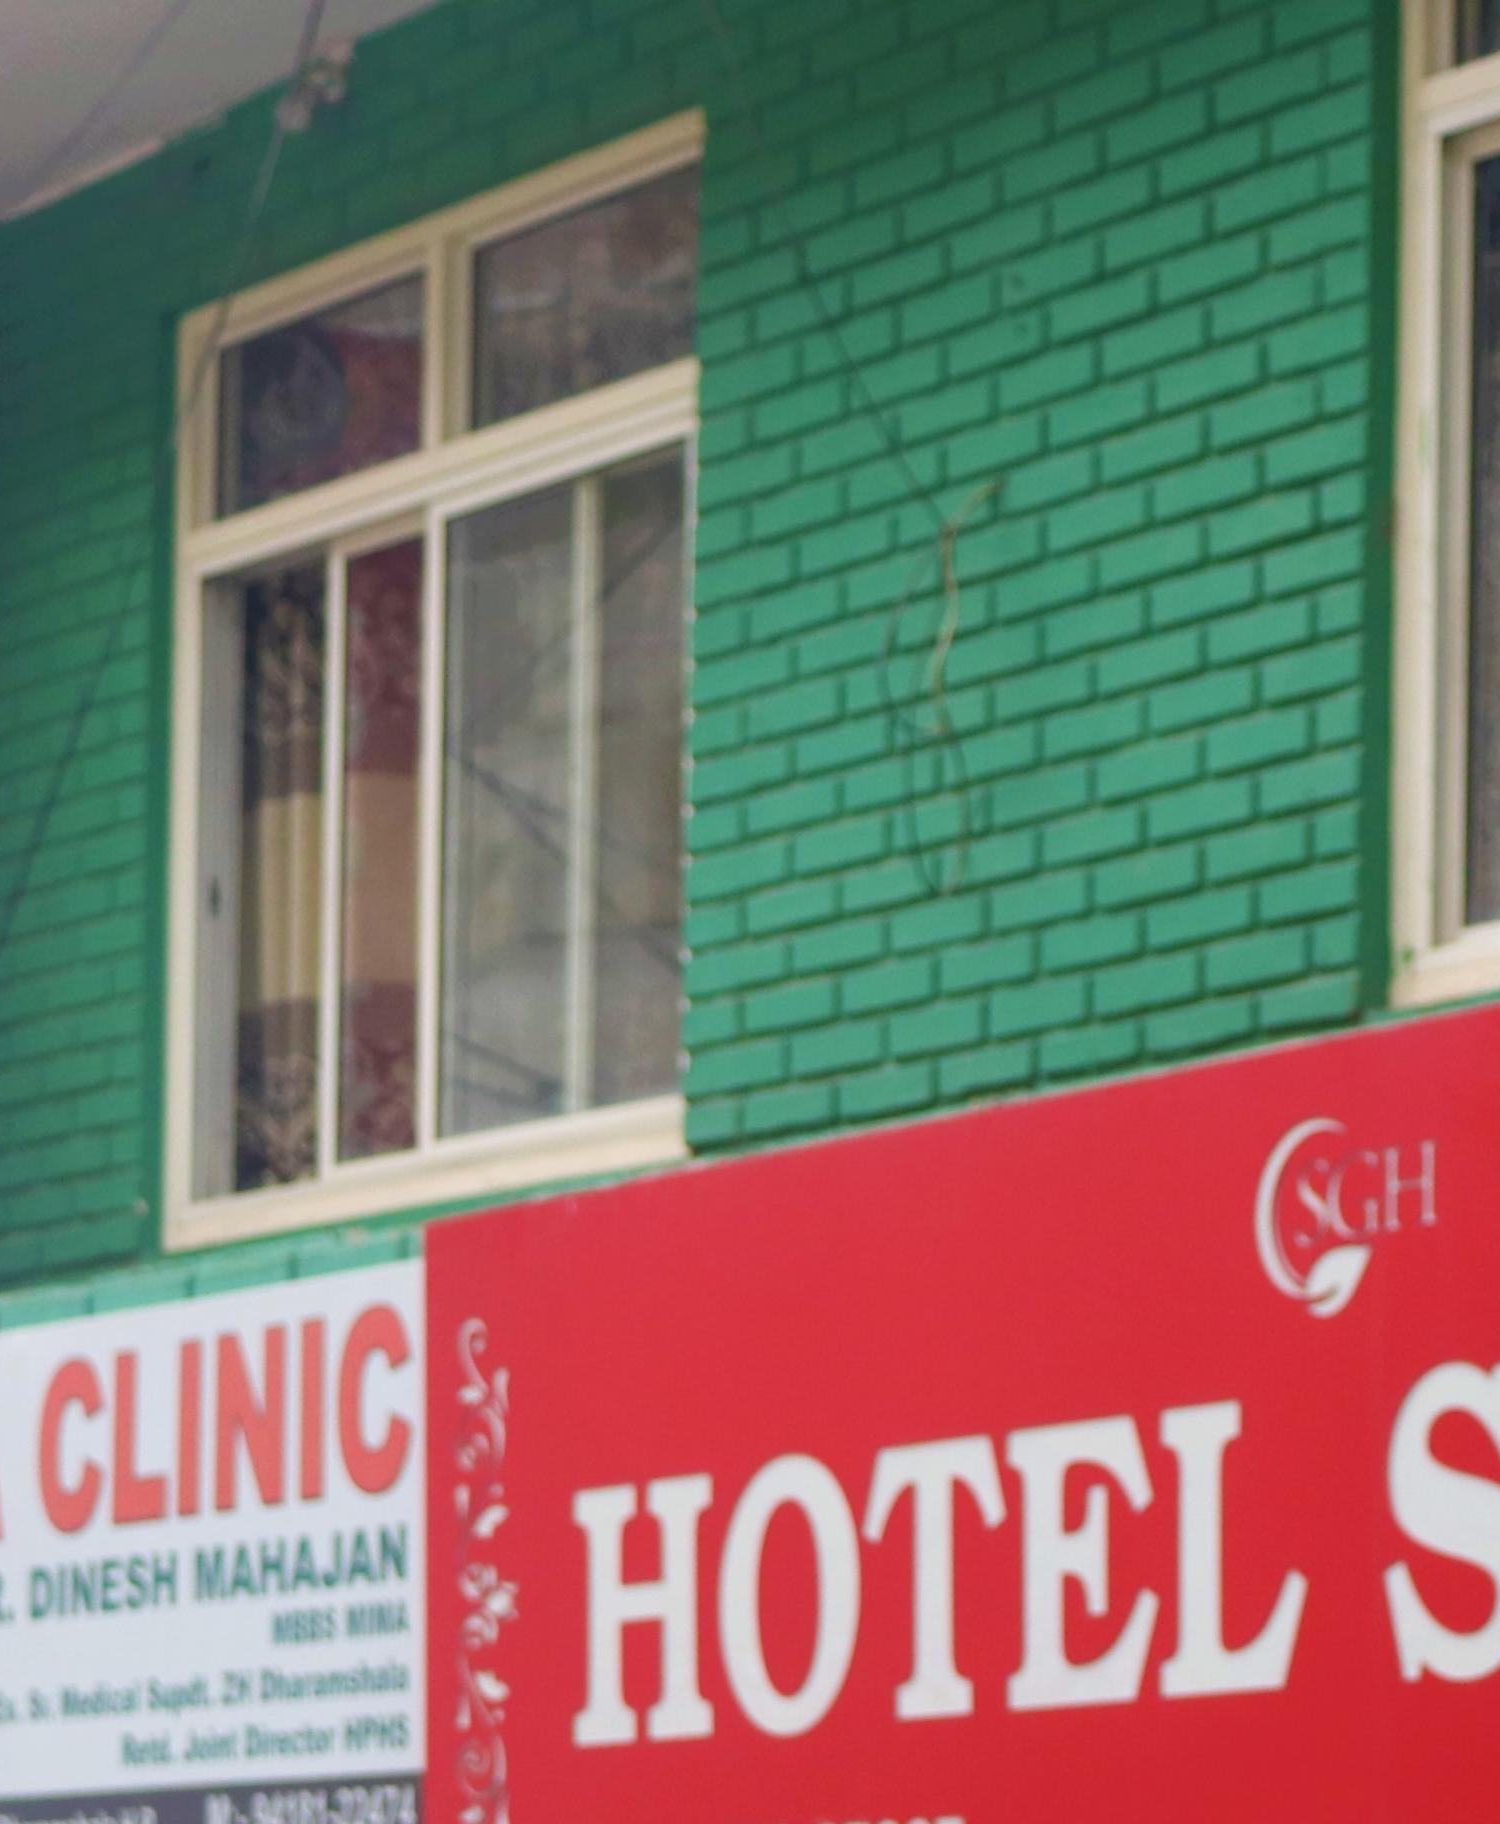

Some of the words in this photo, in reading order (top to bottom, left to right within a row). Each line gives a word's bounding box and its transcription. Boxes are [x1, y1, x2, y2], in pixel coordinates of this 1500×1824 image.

[1294, 1138, 1438, 1248] SGH
[37, 1302, 414, 1535] CLINIC
[29, 1549, 179, 1622] DINESH
[194, 1522, 410, 1604] MAHAJAN
[572, 1399, 1308, 1749] HOTEL
[272, 1606, 337, 1645] MBBS
[61, 1682, 140, 1717] Medical
[184, 1729, 238, 1762] Joint
[245, 1723, 335, 1759] Director
